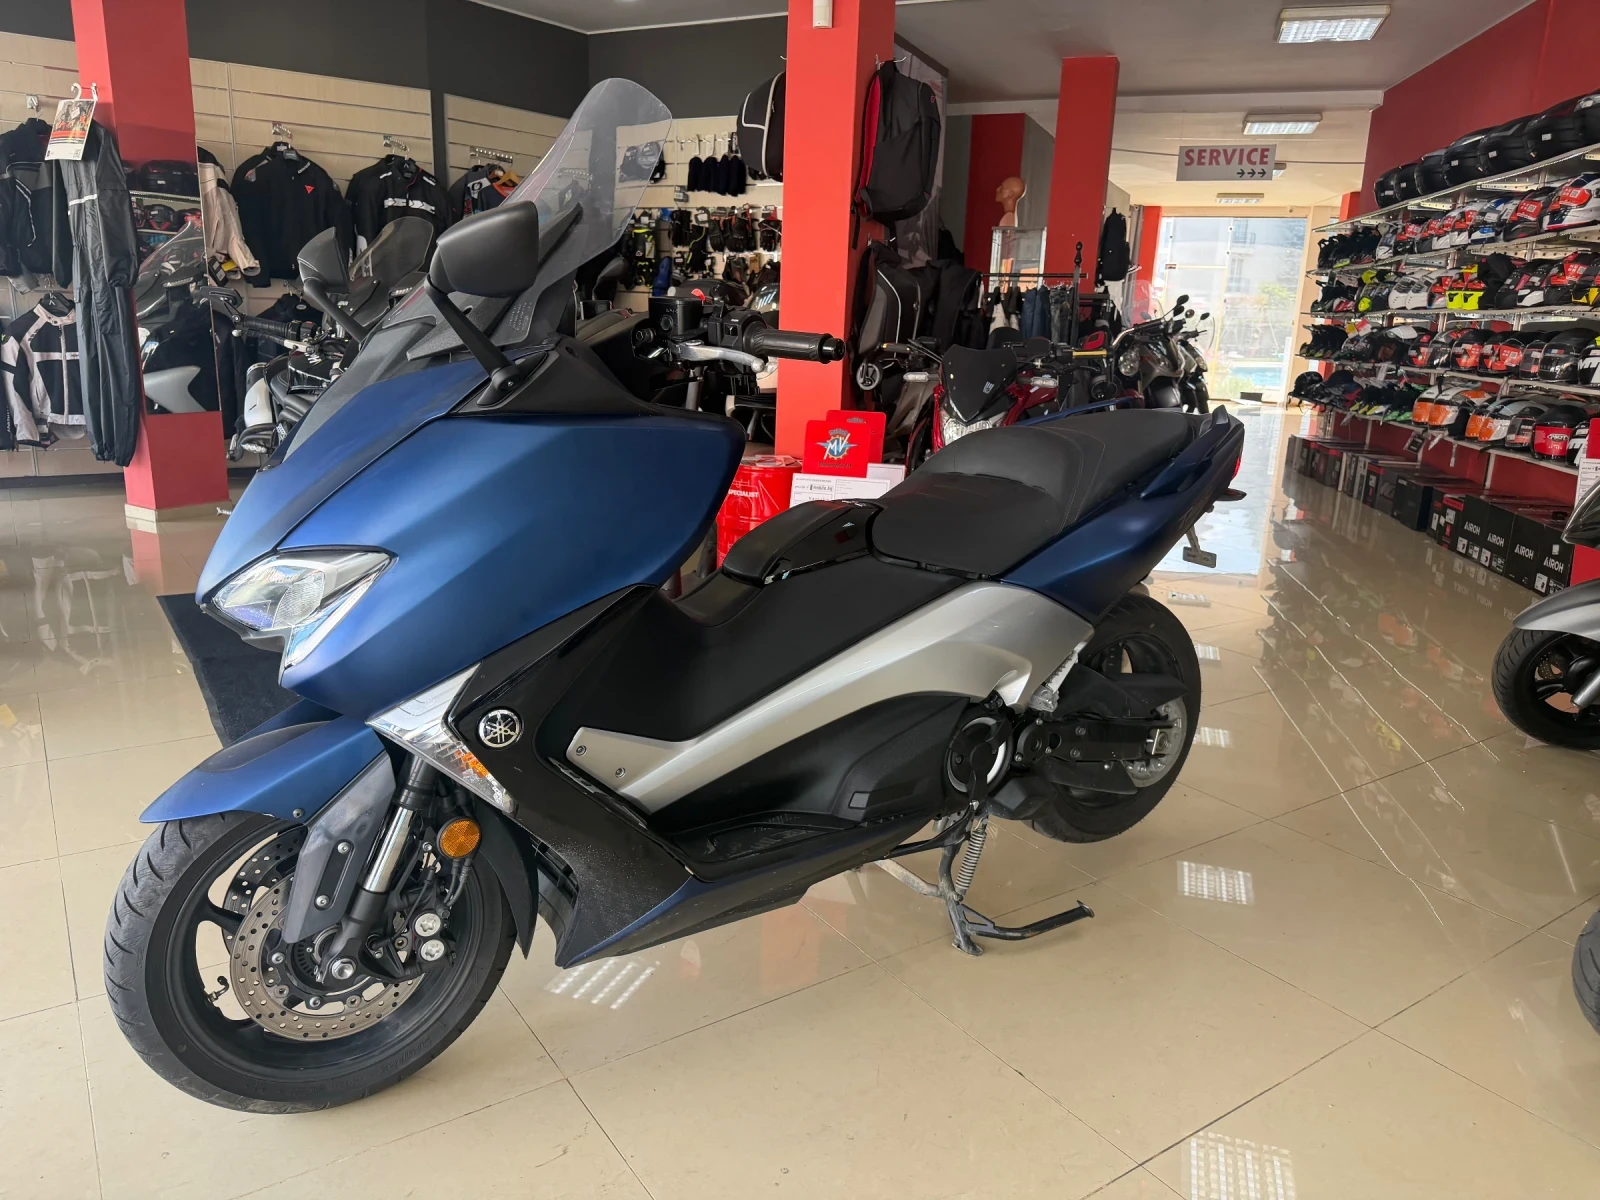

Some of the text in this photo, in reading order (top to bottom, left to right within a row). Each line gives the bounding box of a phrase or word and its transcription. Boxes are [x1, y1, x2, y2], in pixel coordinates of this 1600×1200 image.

[1184, 148, 1270, 167] SERVICE
[1464, 521, 1481, 536] AIROH
[1487, 532, 1504, 548] AIROH
[1514, 543, 1534, 560] AIROH
[1543, 556, 1564, 573] AIROH
